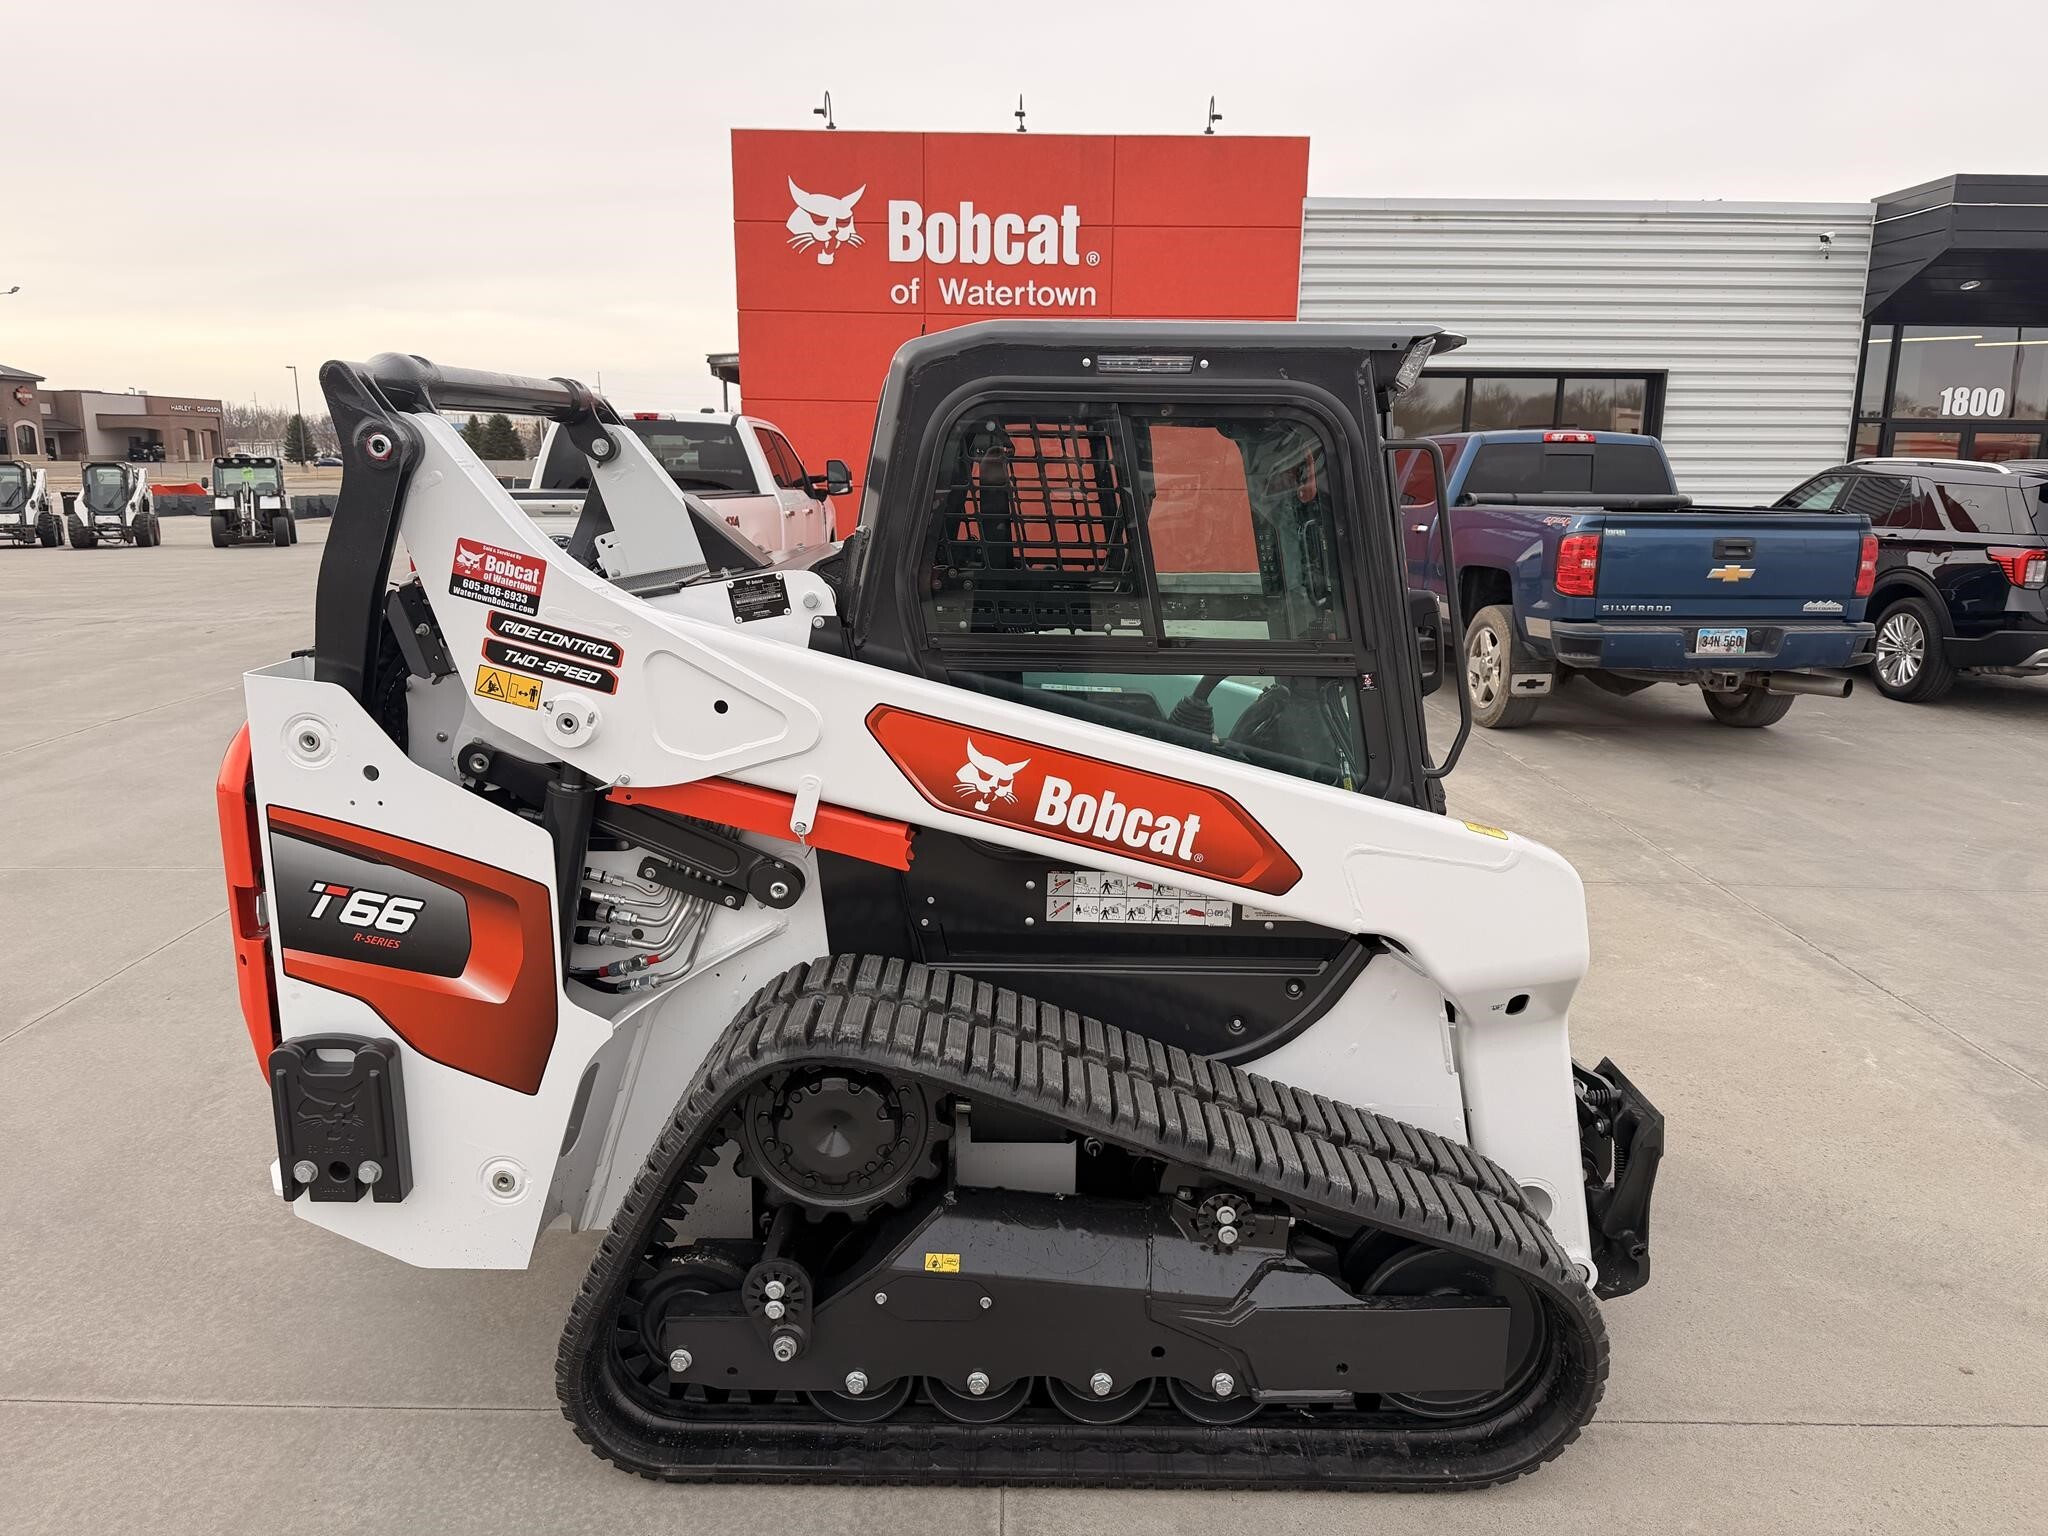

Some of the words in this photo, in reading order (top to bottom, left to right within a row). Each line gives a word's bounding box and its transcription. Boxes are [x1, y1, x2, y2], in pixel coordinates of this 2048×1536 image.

[890, 278, 921, 306] of
[938, 278, 1097, 308] Watertown
[1940, 386, 2006, 417] 1800
[462, 578, 528, 604] 605-886-6933
[493, 574, 537, 593] Watertown
[453, 586, 535, 614] WatertownBobcat.com
[1602, 604, 1672, 612] SILVERADO
[499, 620, 541, 640] RIDE
[537, 629, 614, 661] CONTROL
[1701, 635, 1721, 648] 34N
[1723, 635, 1743, 648] 560
[504, 649, 602, 685] TWO-SPEED
[309, 881, 426, 935] T66
[353, 932, 402, 950] R-SERIES
